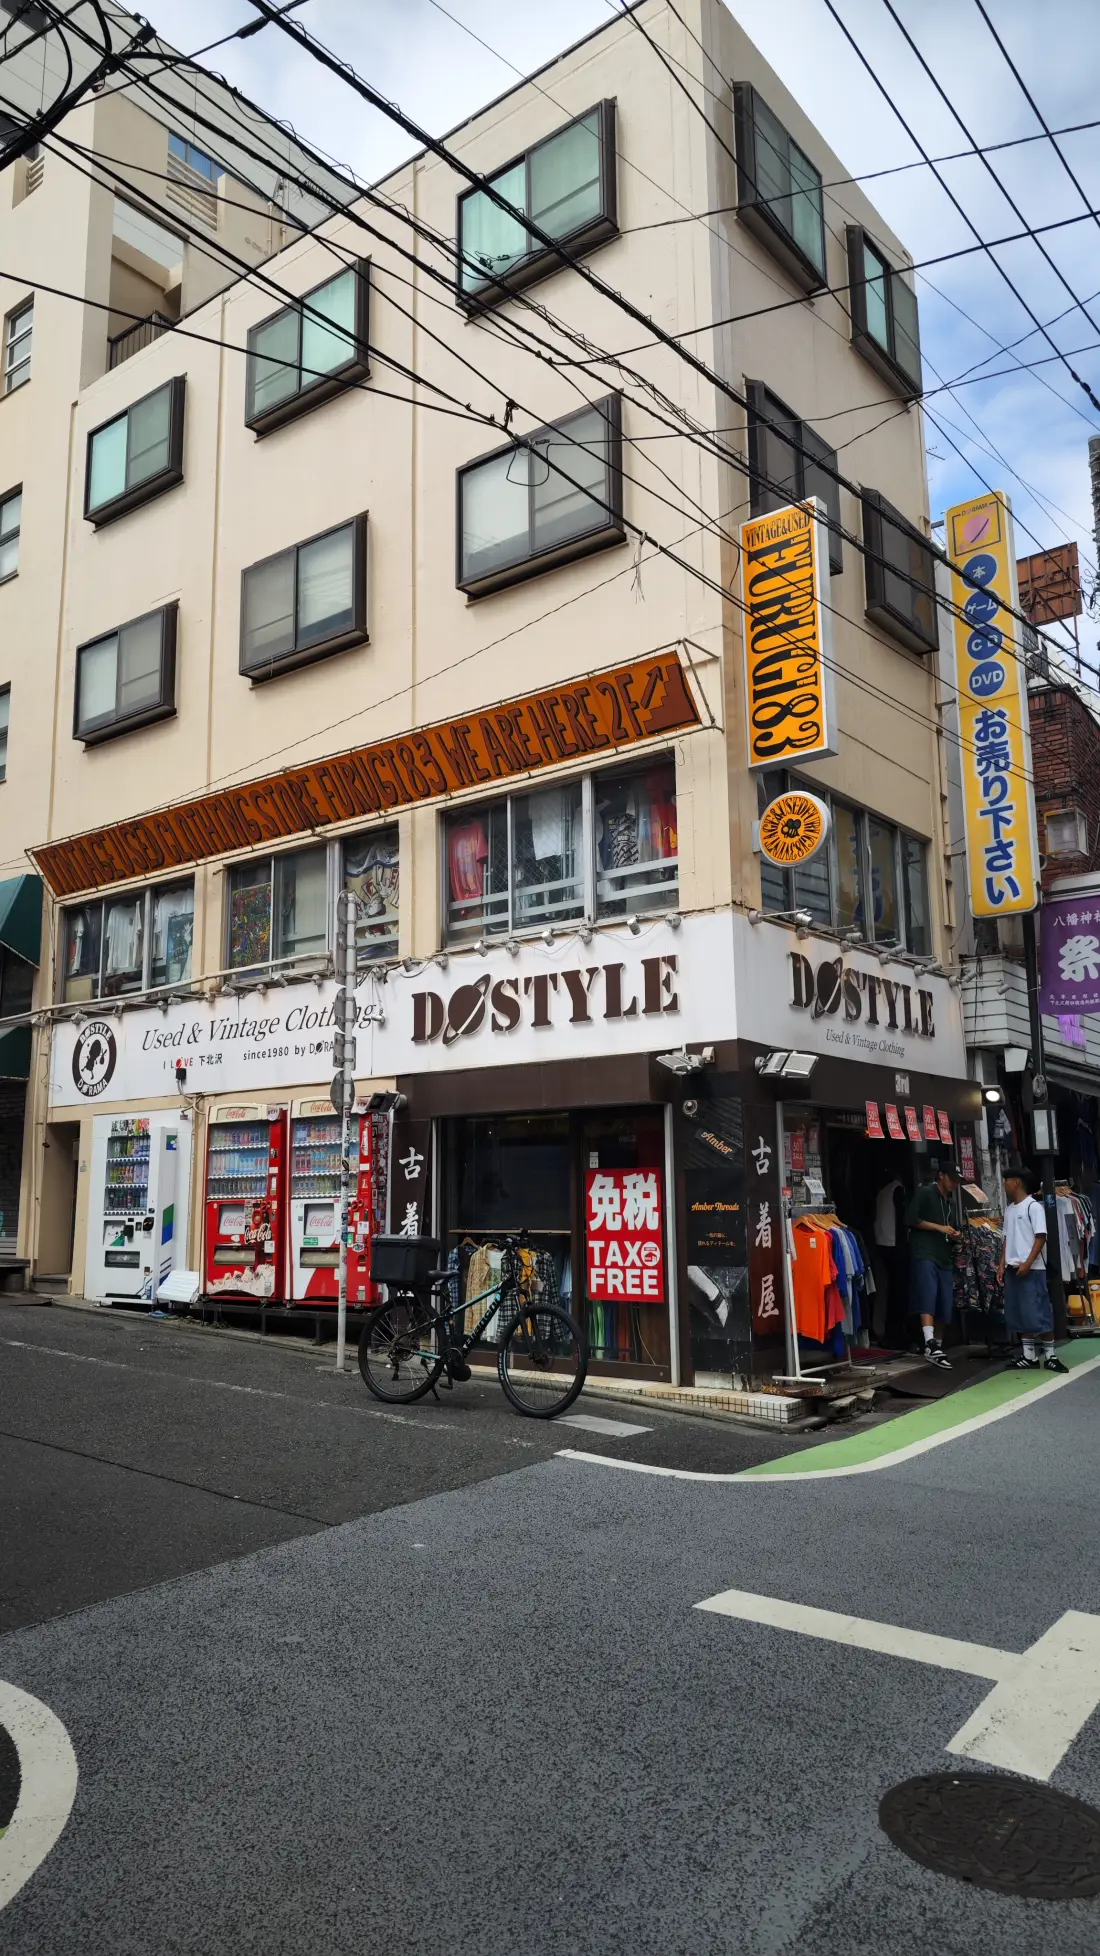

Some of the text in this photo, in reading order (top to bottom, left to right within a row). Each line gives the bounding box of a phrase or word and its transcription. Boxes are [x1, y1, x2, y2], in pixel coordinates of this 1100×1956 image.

[972, 566, 986, 578] 本
[967, 598, 998, 614] ゲーム
[747, 529, 821, 758] FURUGI83
[971, 669, 1003, 688] DVD
[39, 831, 124, 897] VINTAGE
[106, 822, 165, 874] USED
[152, 792, 262, 864] CLOTHING
[252, 773, 330, 837] STORE
[435, 723, 491, 786] WE
[478, 707, 543, 777] ARE
[526, 686, 611, 761] HERE
[596, 672, 647, 741] 2F
[974, 708, 1020, 906] お売り下さい
[1058, 935, 1100, 982] 祭
[142, 1003, 377, 1051] Used & Vintage Clotng
[243, 1045, 289, 1061] since1980
[294, 1044, 306, 1056] by
[825, 1028, 905, 1058] Used & Vintage Clothing
[199, 1053, 223, 1067] 下北沢
[895, 1074, 910, 1094] 3rd
[700, 1131, 733, 1155] Amber
[587, 1172, 660, 1232] 免税
[691, 1202, 714, 1211] Amber
[751, 1135, 780, 1319] 古着屋
[588, 1240, 643, 1267] TAX
[590, 1267, 659, 1296] FREE
